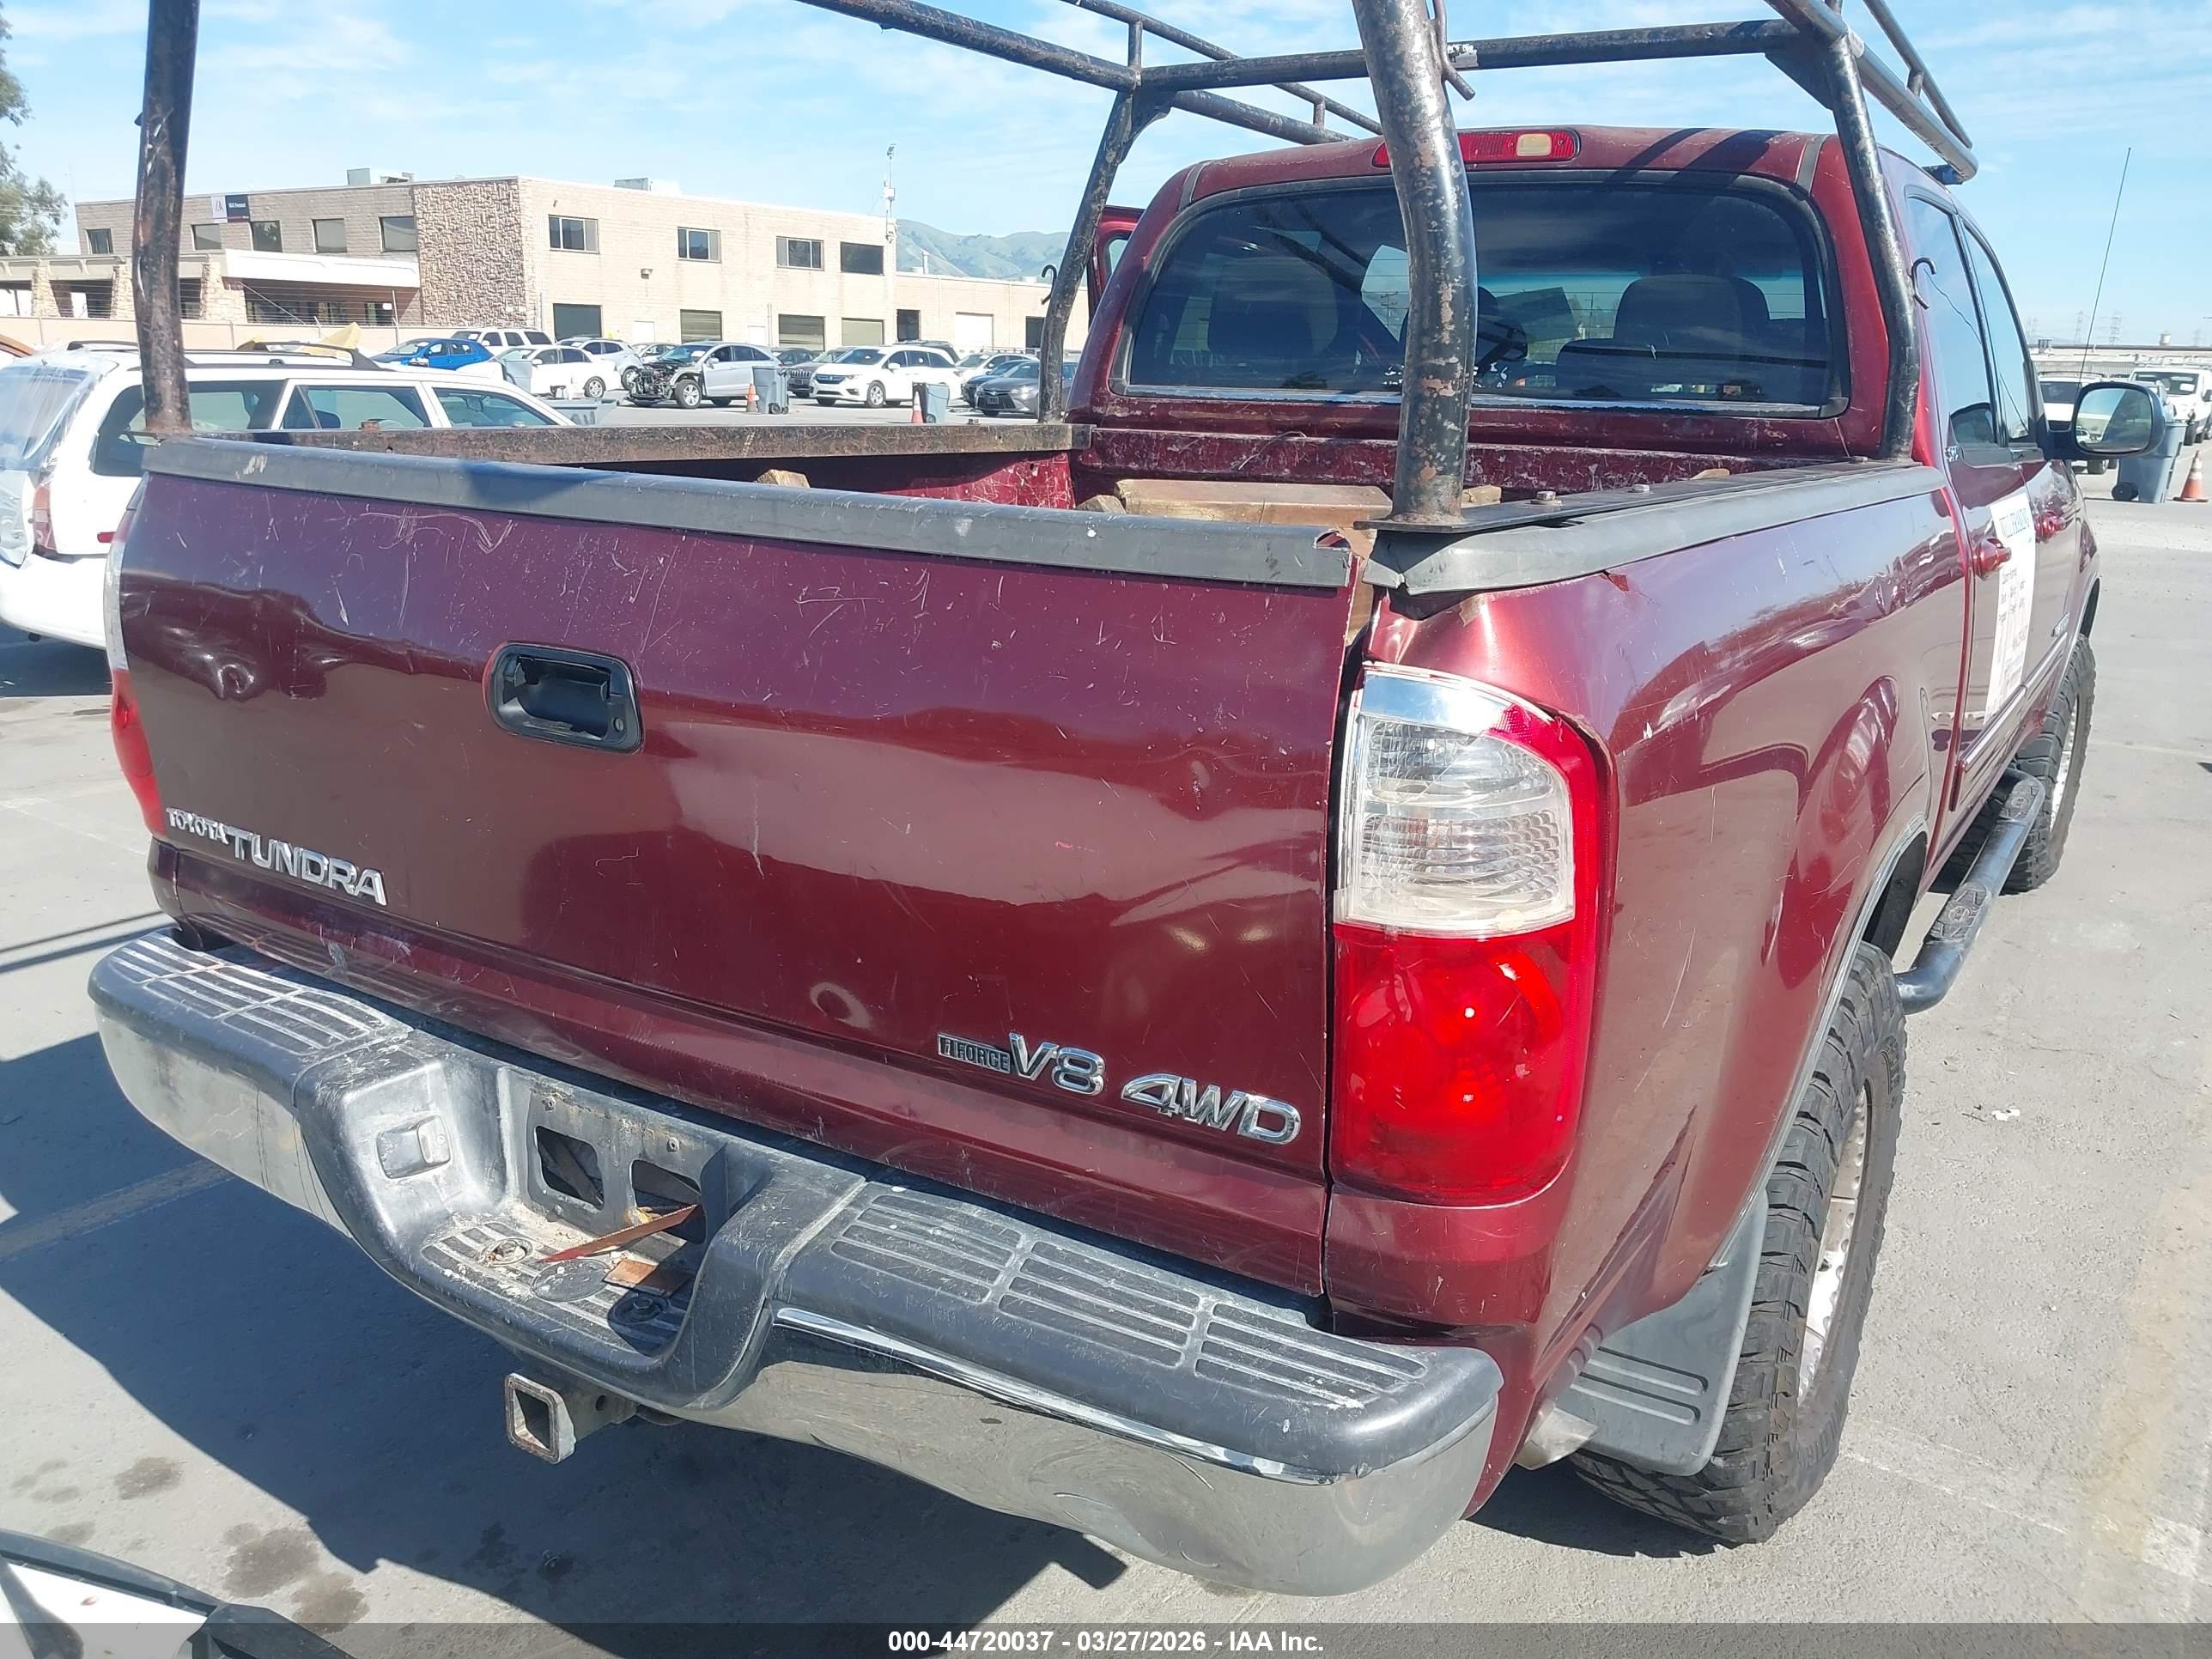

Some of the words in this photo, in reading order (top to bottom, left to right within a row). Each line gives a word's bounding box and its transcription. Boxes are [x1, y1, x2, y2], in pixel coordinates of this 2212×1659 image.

[166, 807, 229, 845] TOYOTA
[226, 825, 386, 906] TUNDRA
[1009, 1032, 1106, 1097] V8
[1121, 1073, 1302, 1146] 4WD
